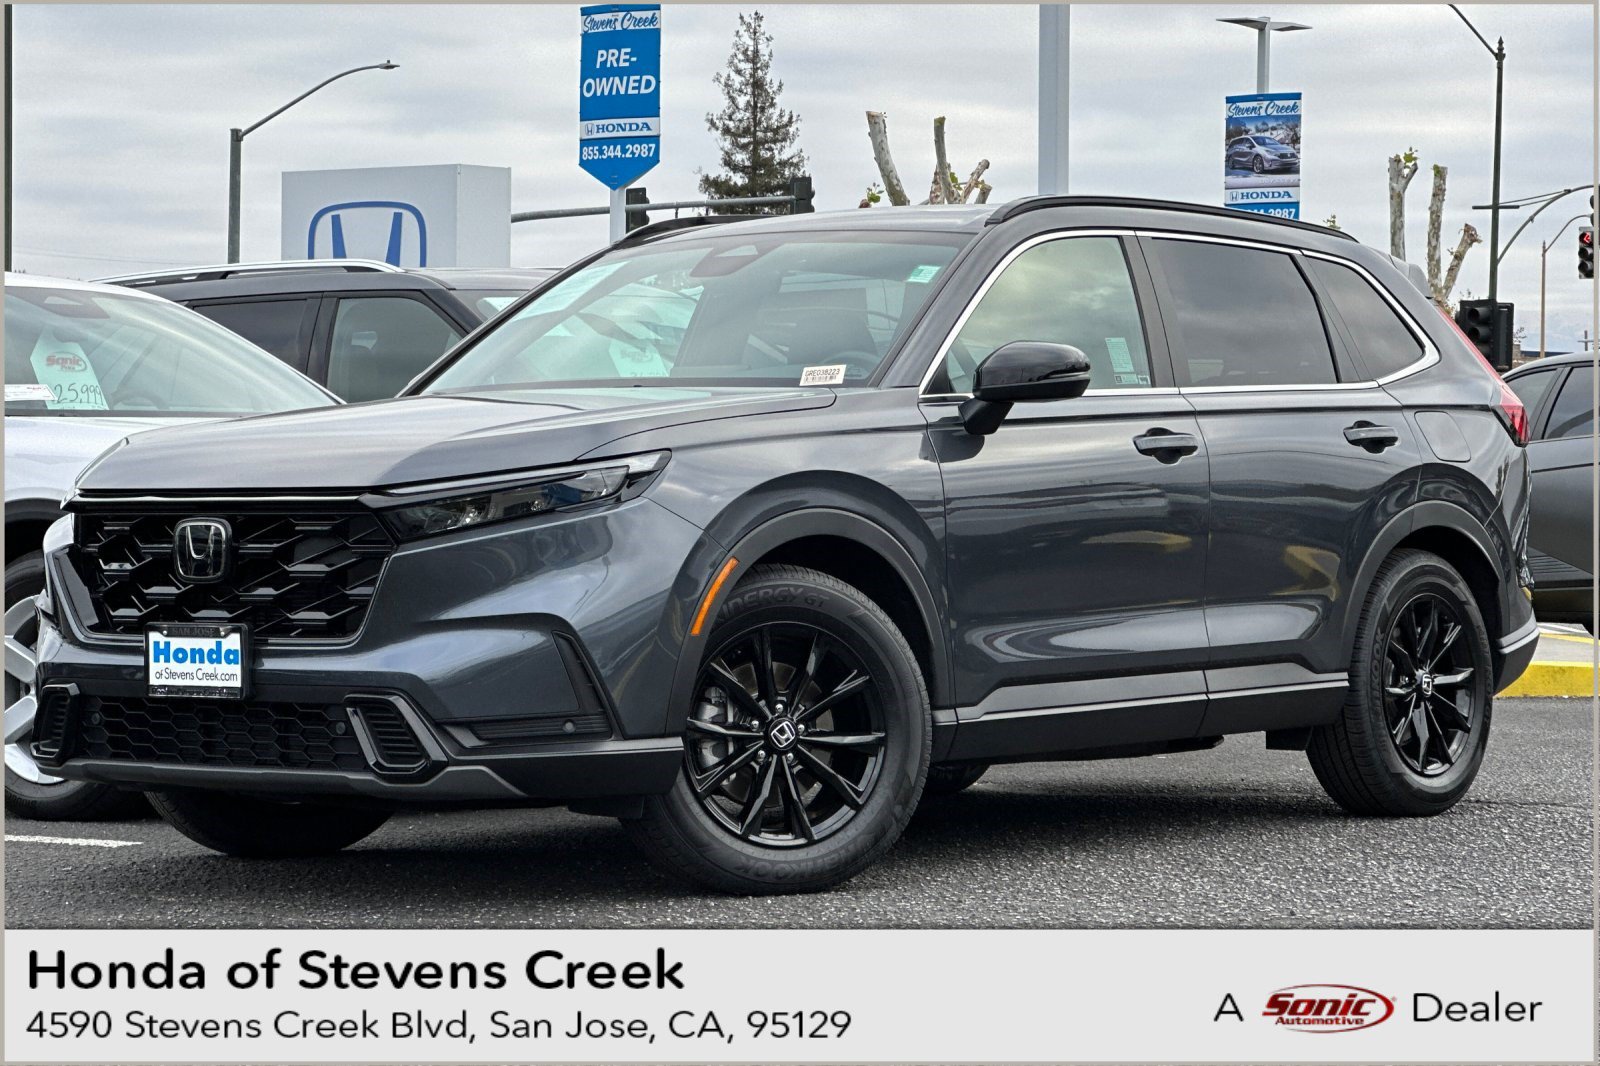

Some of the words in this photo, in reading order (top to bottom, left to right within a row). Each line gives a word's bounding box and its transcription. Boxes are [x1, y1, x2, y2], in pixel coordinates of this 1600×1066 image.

[583, 15, 618, 33] Stevens
[621, 12, 659, 30] Creek
[596, 48, 637, 68] PRE-
[583, 75, 656, 97] OWNED
[1228, 103, 1263, 117] Stevens
[1265, 101, 1299, 116] Creek
[596, 122, 652, 133] HONDA
[582, 144, 655, 160] 855.344.2987
[1241, 191, 1292, 200] HONDA
[53, 383, 104, 406] 25,999
[153, 641, 240, 665] Honda
[155, 669, 164, 680] of
[164, 667, 194, 681] Stevens
[196, 667, 238, 682] Creek.com
